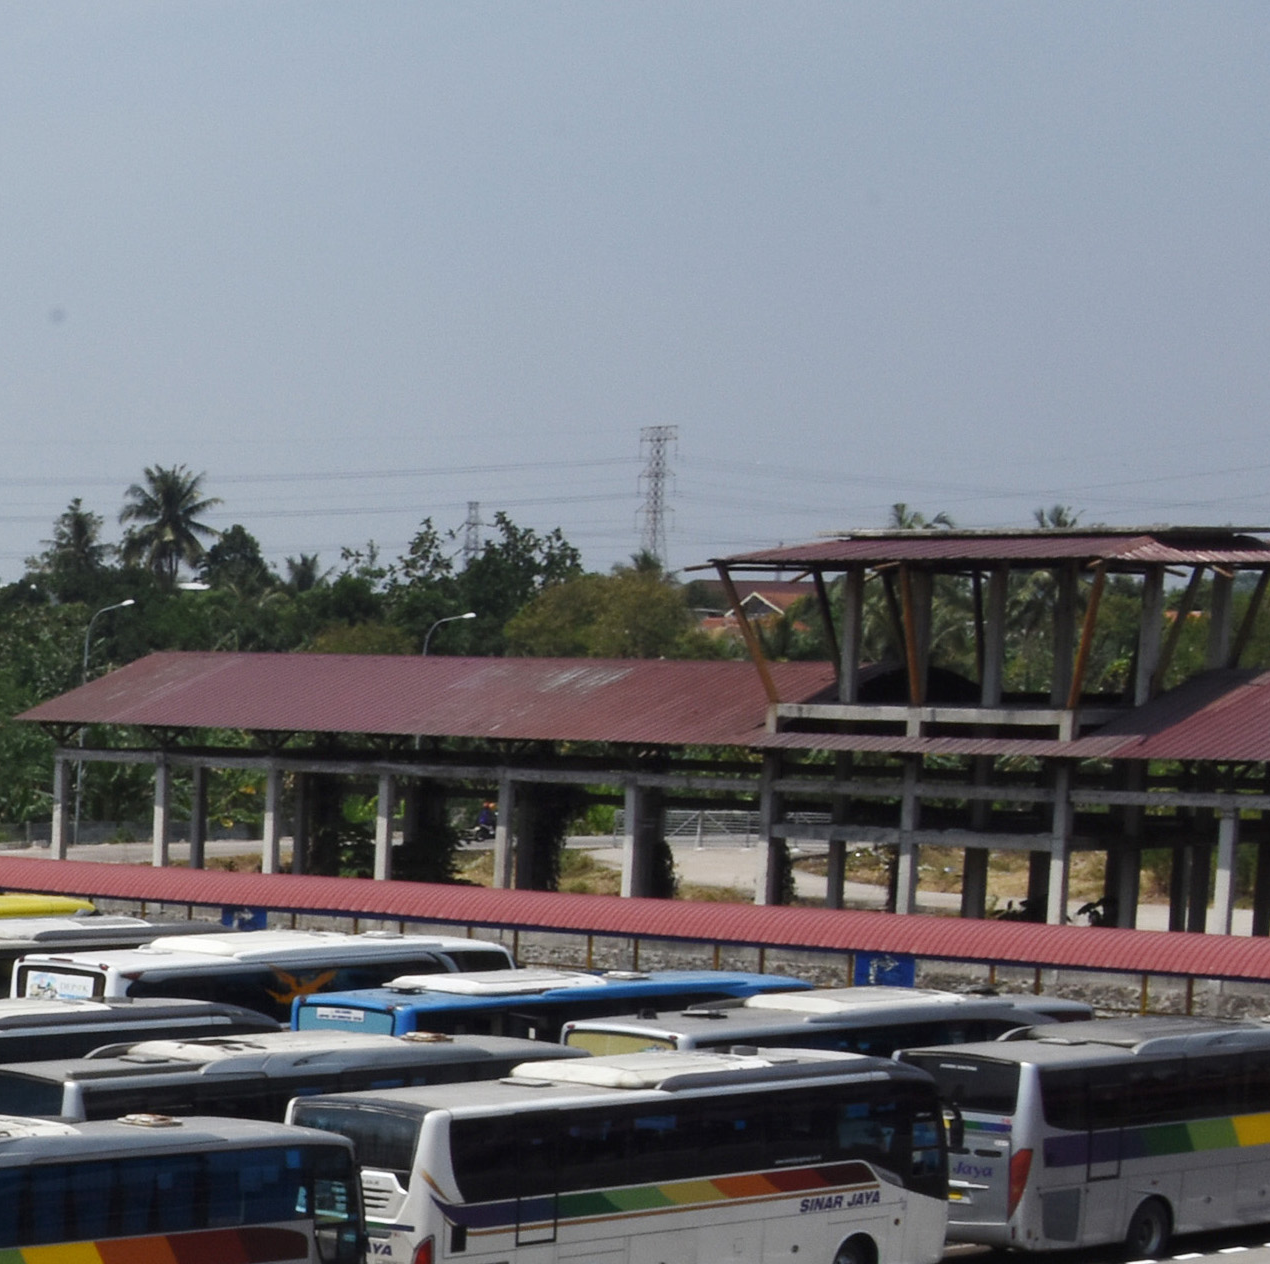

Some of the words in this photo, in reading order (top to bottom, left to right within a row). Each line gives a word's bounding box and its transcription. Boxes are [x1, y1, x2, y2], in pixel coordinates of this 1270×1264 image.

[953, 1161, 993, 1178] Jaya
[800, 1195, 843, 1212] SINAR
[847, 1190, 880, 1207] JAYA
